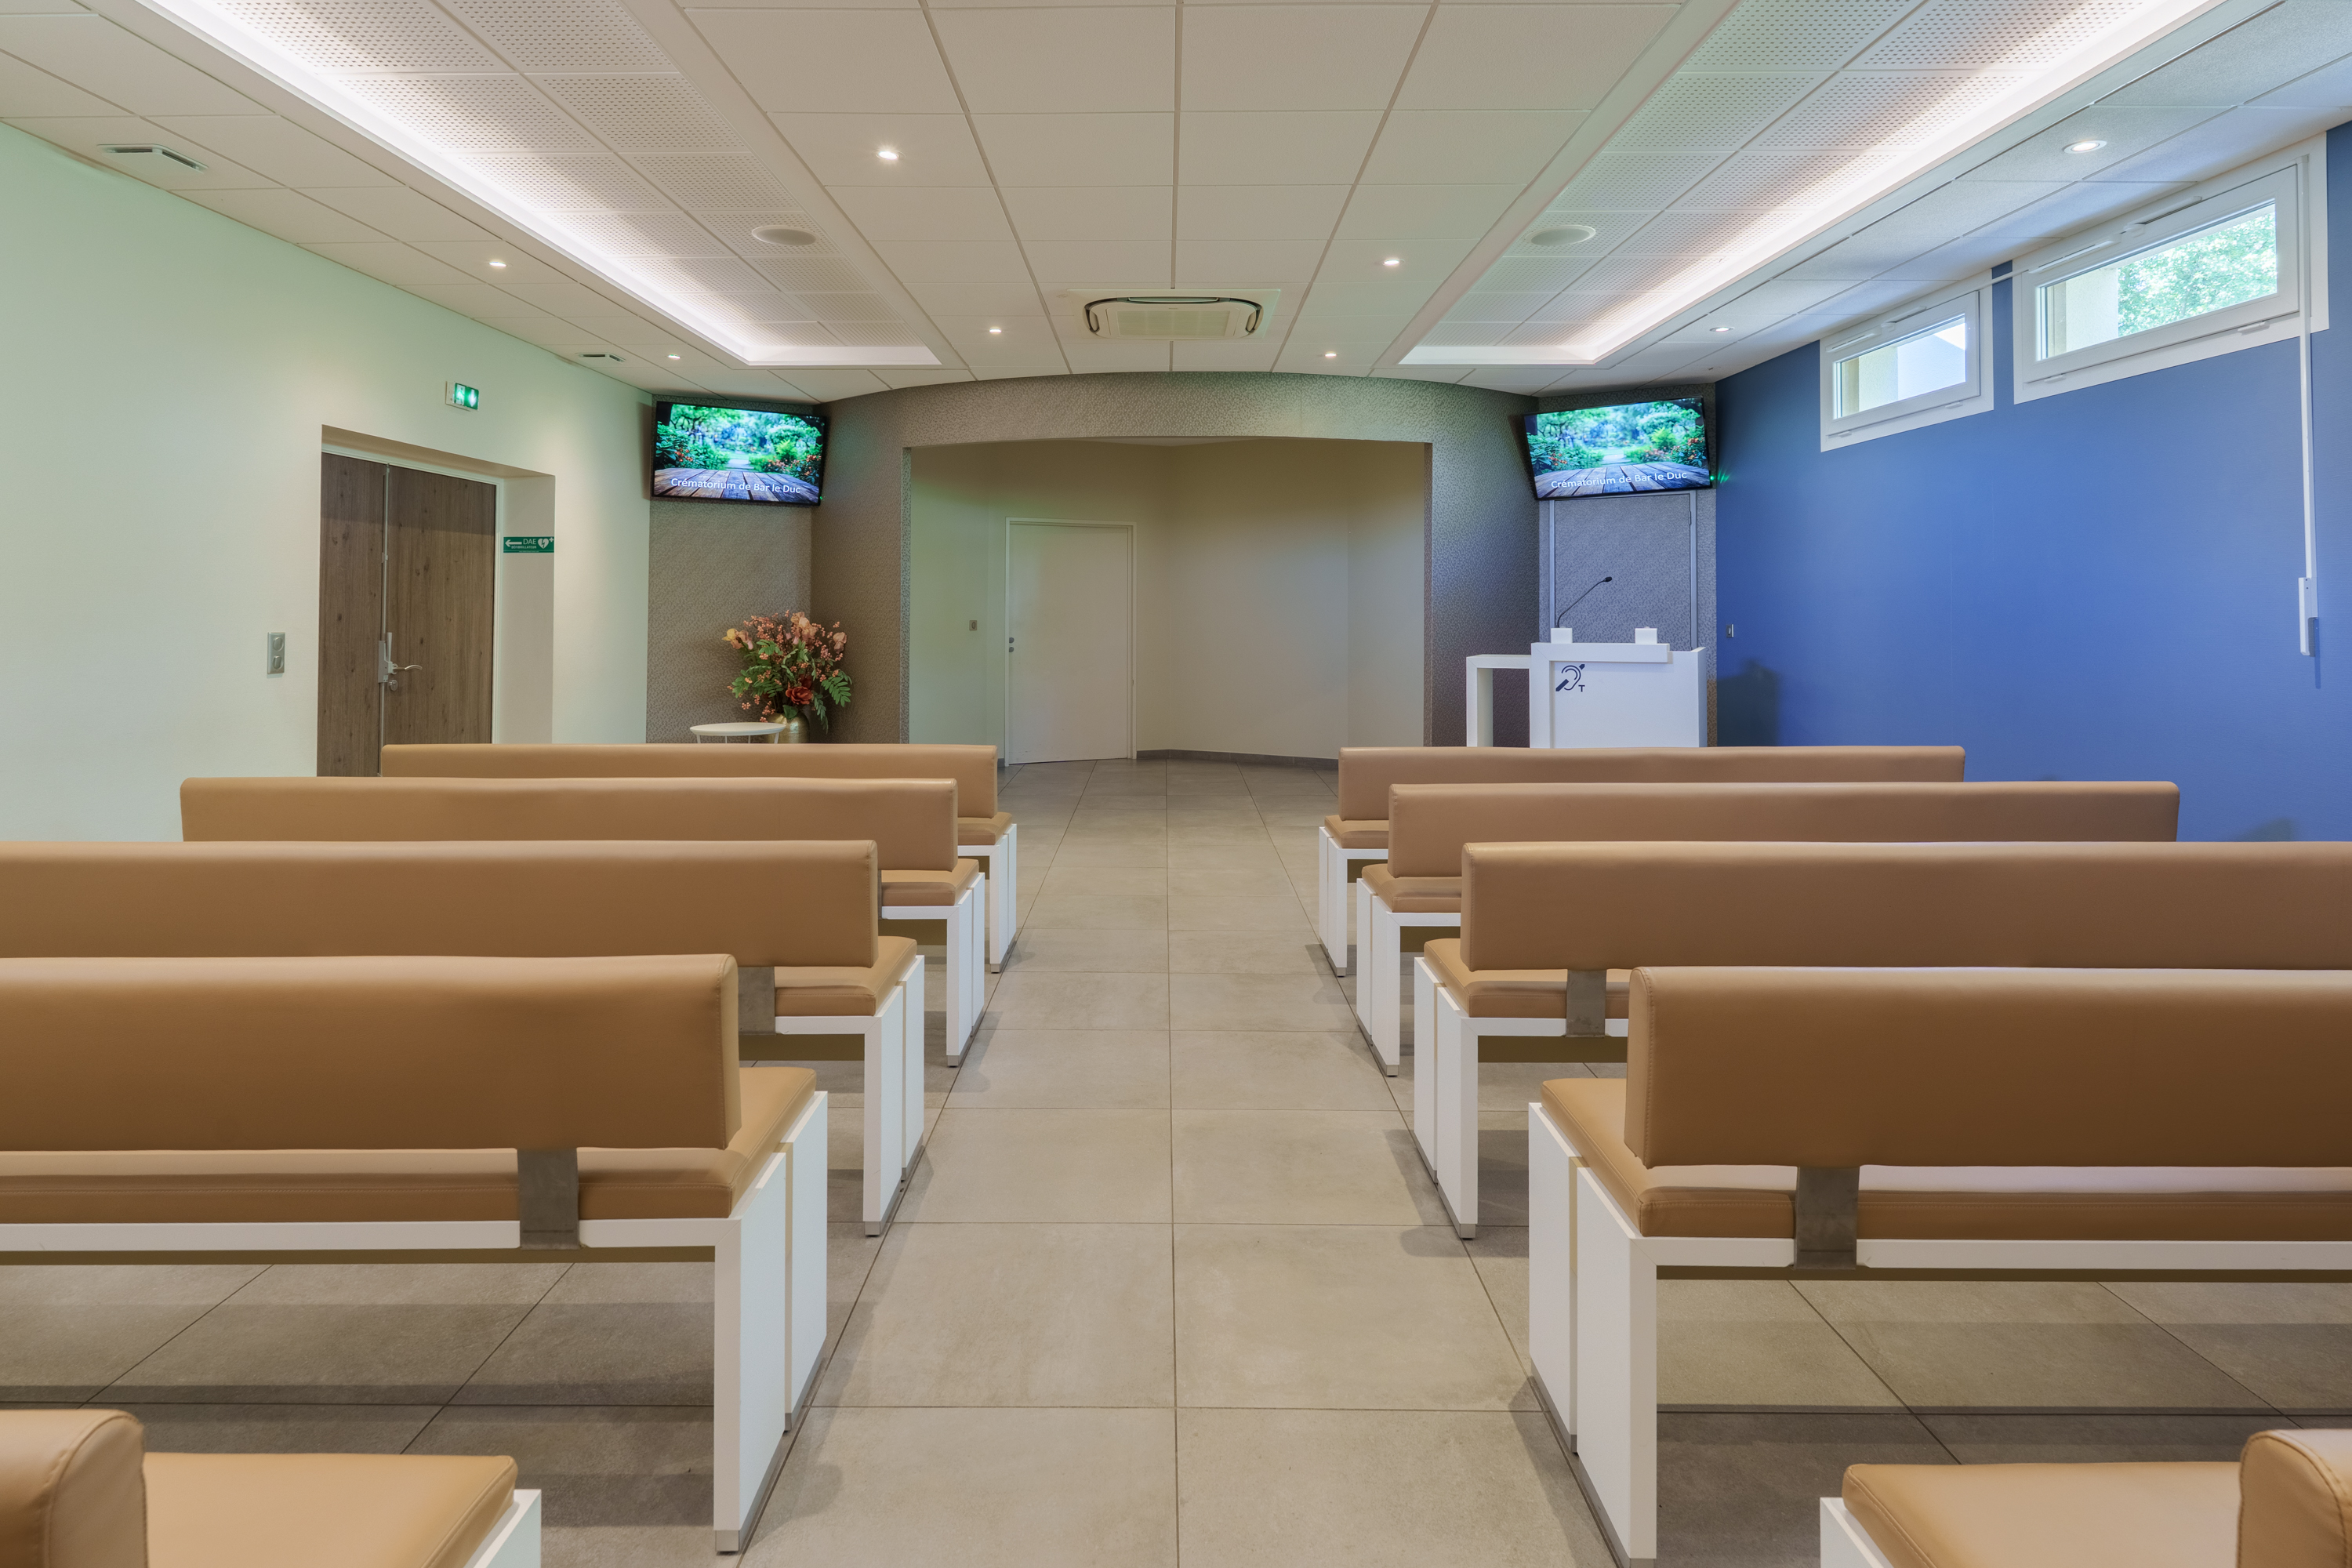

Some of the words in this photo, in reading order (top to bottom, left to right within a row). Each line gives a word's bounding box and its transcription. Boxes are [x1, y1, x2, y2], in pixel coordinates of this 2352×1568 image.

[671, 478, 736, 490] Crématorium
[753, 483, 770, 492] Bar
[772, 484, 781, 492] le
[783, 485, 800, 494] Duc
[1552, 477, 1616, 488] Crématorium
[1654, 472, 1664, 481] le
[1667, 471, 1687, 480] Duc
